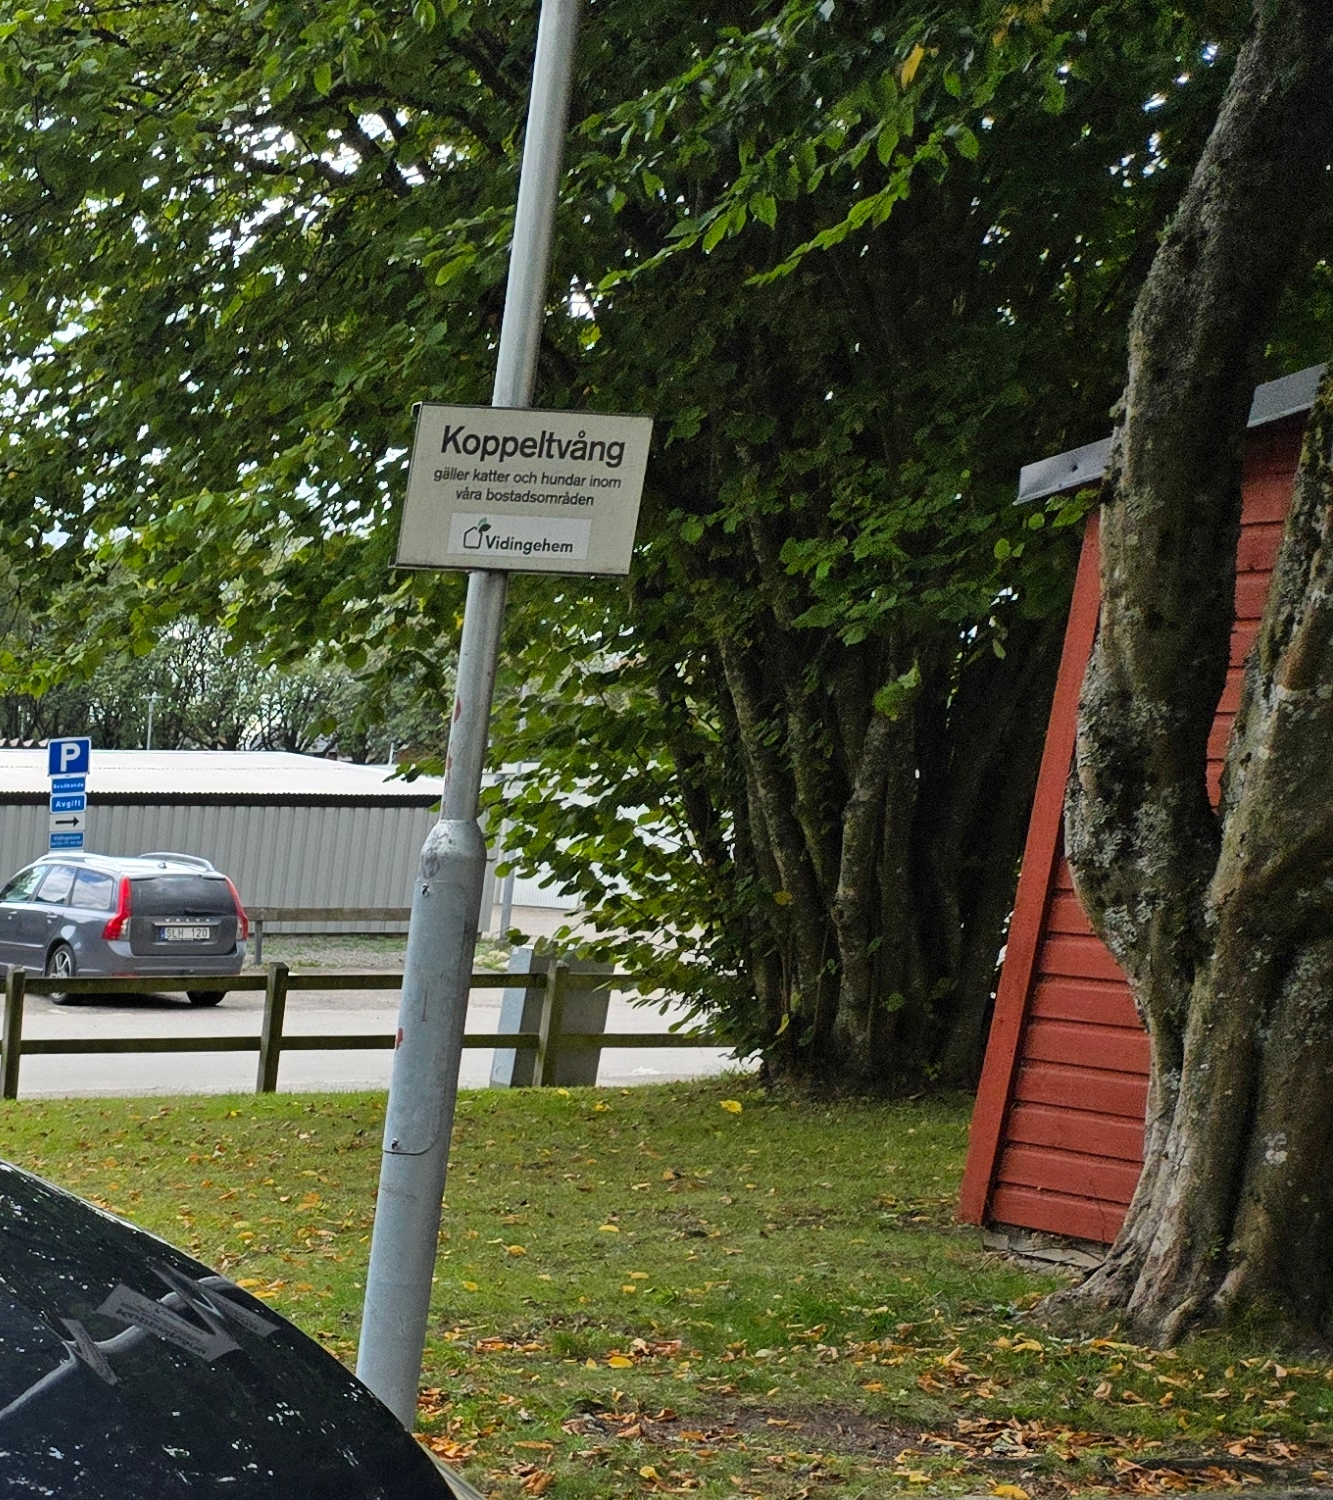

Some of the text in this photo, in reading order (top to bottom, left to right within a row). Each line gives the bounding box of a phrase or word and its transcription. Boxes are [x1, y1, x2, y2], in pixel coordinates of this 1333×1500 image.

[441, 425, 625, 468] Koppeltvång
[434, 468, 621, 488] gäller katter och hundar inom
[456, 488, 594, 506] våra bostadsområden
[485, 535, 573, 554] Vidingehem
[60, 743, 80, 772] P
[56, 800, 81, 808] Avgift
[166, 928, 207, 937] SLH 120
